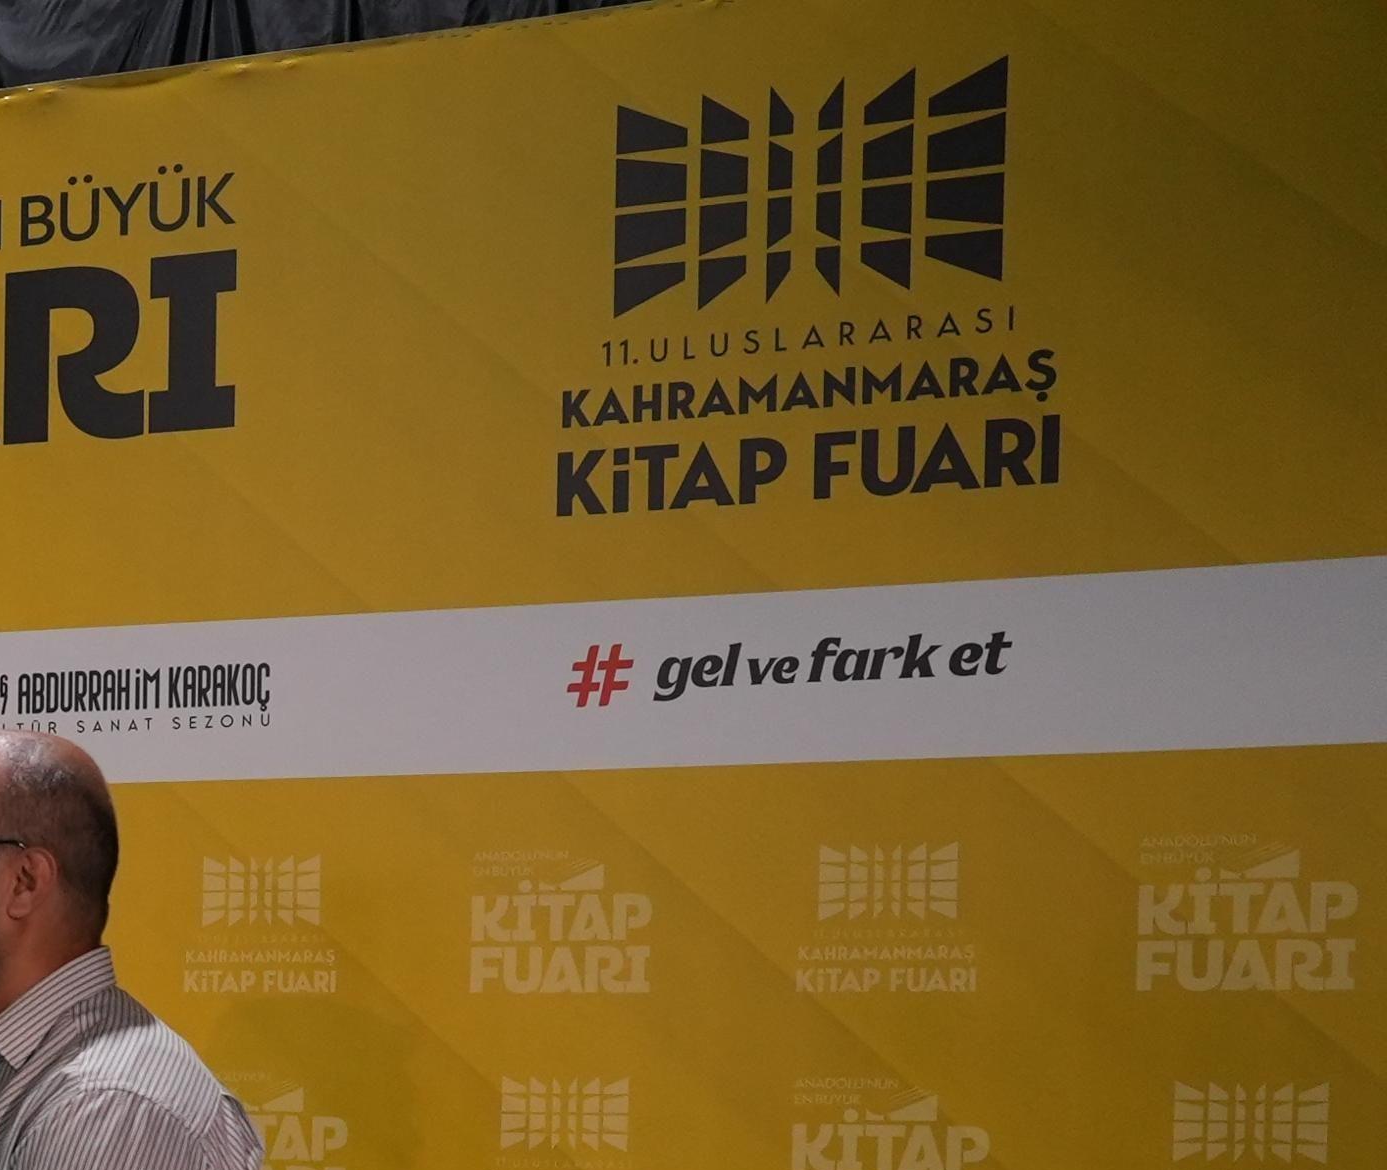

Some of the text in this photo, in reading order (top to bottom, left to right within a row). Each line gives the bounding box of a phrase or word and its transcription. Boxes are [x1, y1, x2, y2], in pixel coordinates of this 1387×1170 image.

[19, 164, 239, 248] BÜYÜK
[561, 348, 1057, 430] KAHRAMANMARAŞ
[812, 413, 1061, 501] FUARI
[168, 662, 271, 712] KARAKOÇ
[653, 642, 741, 702] gel
[747, 654, 797, 686] ve
[806, 635, 943, 684] fark
[948, 631, 1013, 677] et
[76, 718, 154, 733] SANAT
[172, 713, 271, 731] SEZONU
[471, 879, 653, 942] KİTAP
[1138, 867, 1359, 935] KİTAP
[262, 970, 337, 993] FUARI
[469, 945, 651, 993] FUARI
[889, 967, 977, 993] FUARI
[1136, 938, 1356, 992] FUARI
[248, 1113, 348, 1161] TAP
